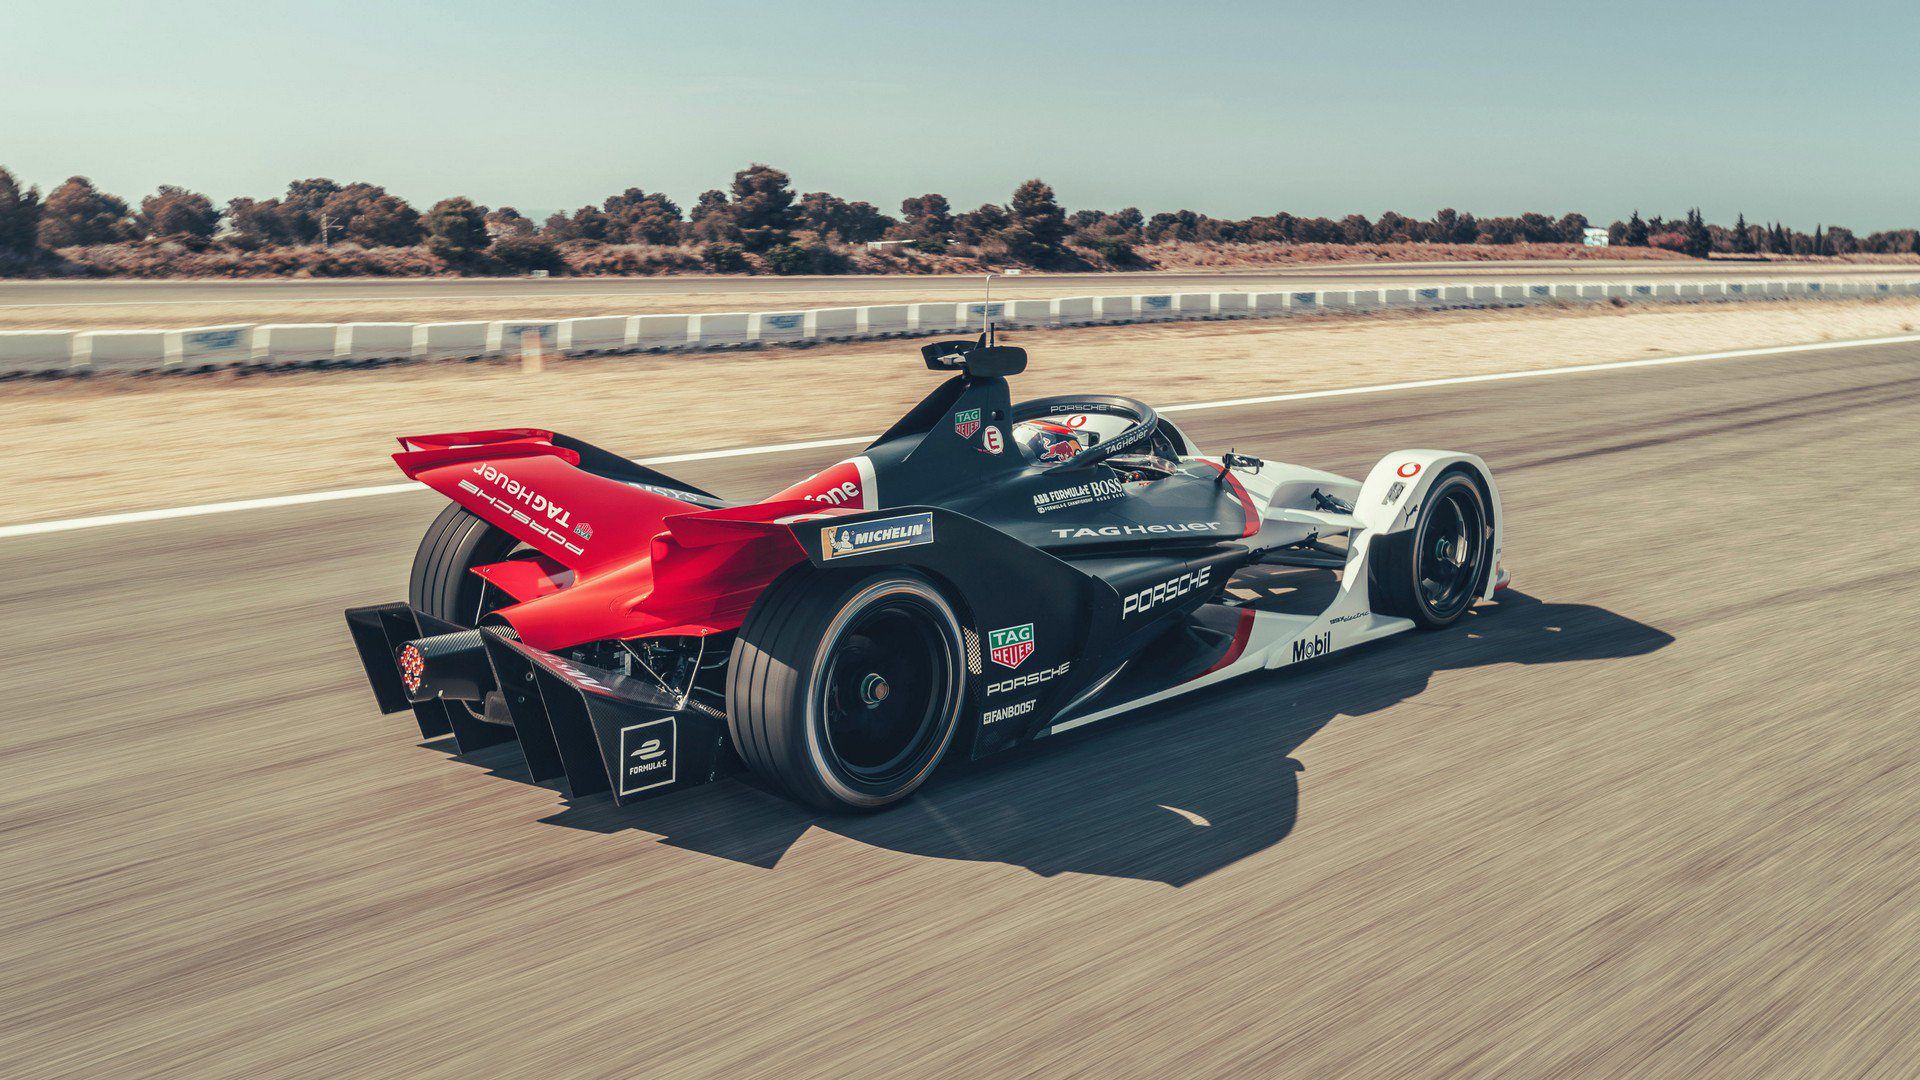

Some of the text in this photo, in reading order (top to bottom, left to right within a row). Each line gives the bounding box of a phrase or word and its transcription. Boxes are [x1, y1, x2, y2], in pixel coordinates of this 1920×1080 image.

[957, 411, 979, 423] TAG
[1050, 404, 1108, 414] PORSCHE
[956, 422, 979, 437] HEUER
[986, 430, 1000, 450] E
[1090, 477, 1123, 498] BOSS
[1032, 493, 1051, 506] ABB
[457, 479, 585, 556] PORSCHE
[854, 523, 924, 545] MICHELIN
[1122, 565, 1212, 620] PORSCHE
[992, 626, 1031, 646] TAG
[1292, 630, 1331, 663] Mobil
[992, 642, 1032, 665] HEUER
[986, 661, 1071, 697] PORSCHE
[991, 699, 1037, 722] FANBOOST
